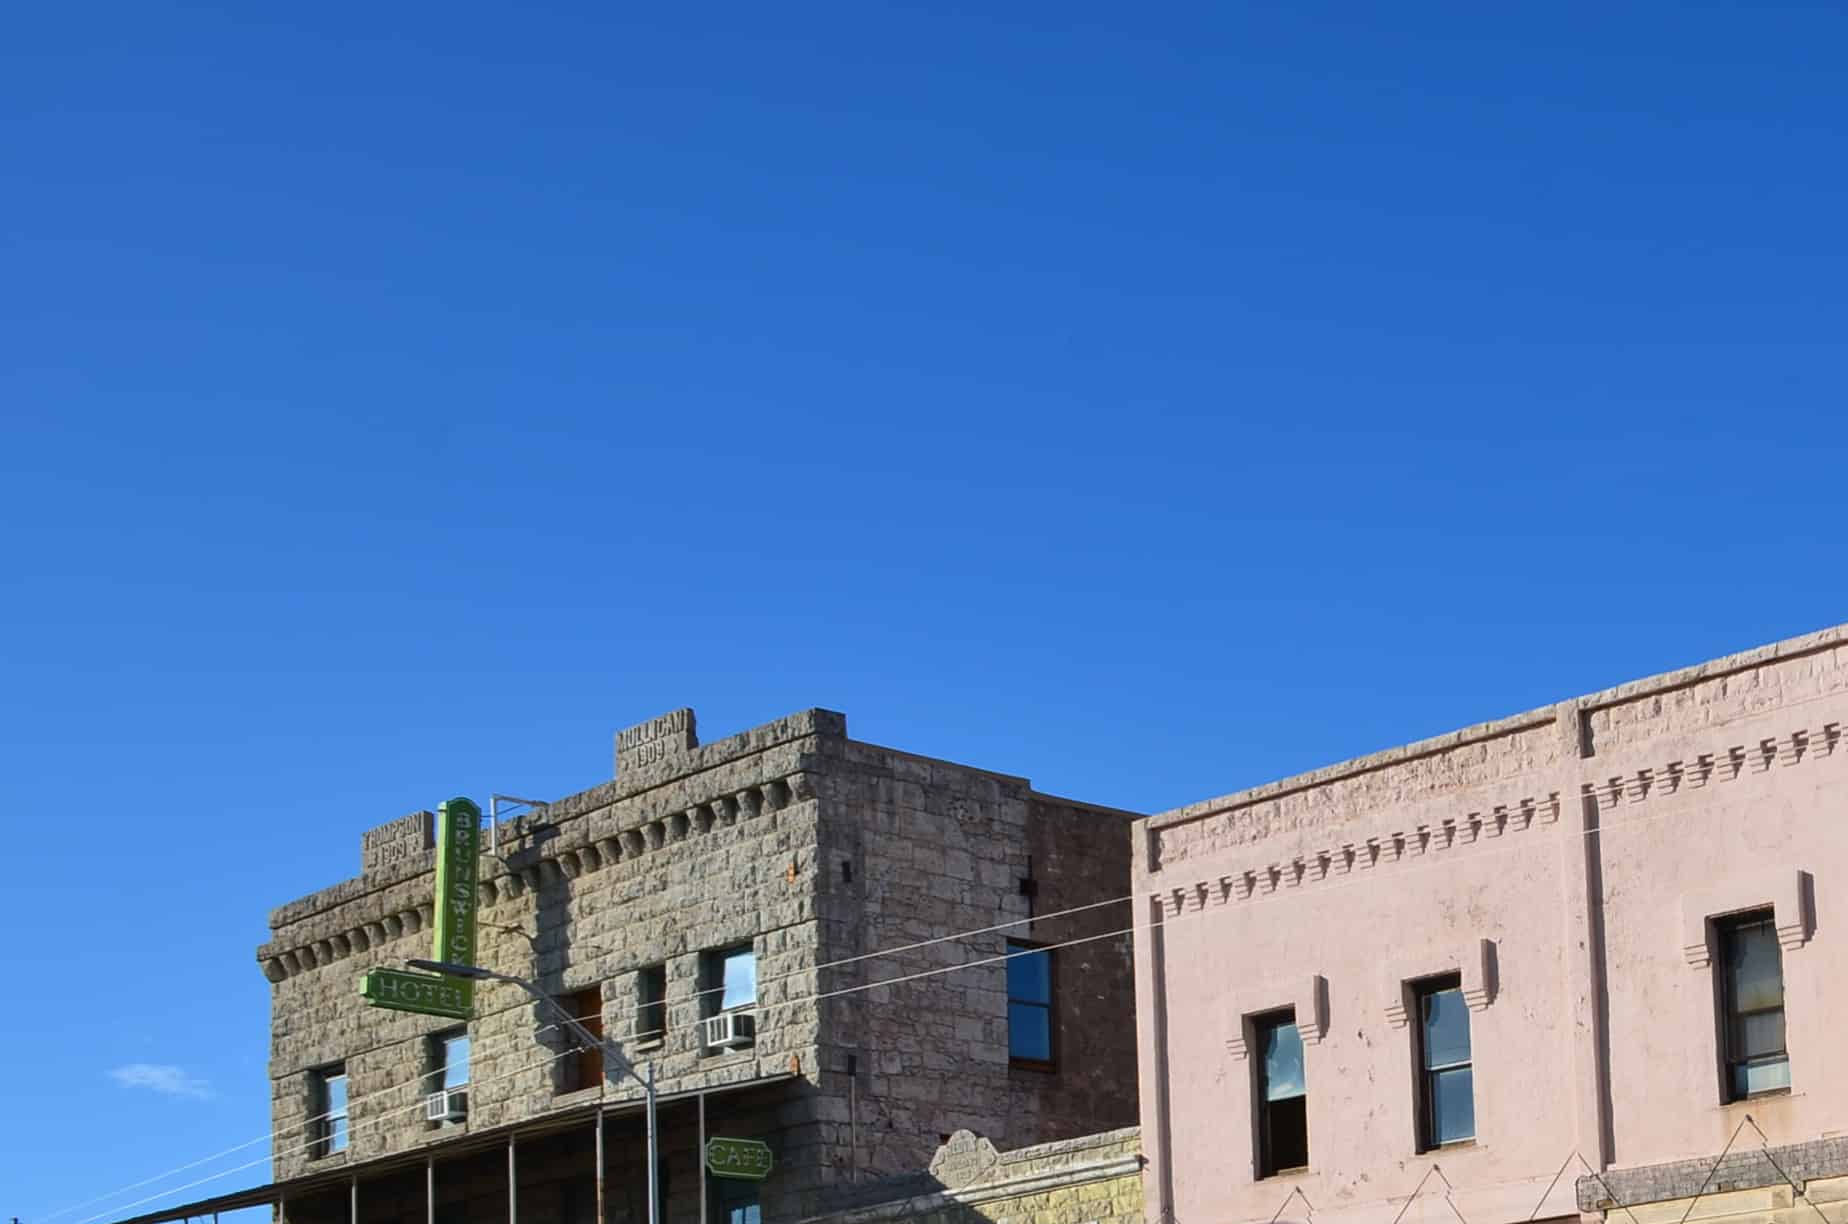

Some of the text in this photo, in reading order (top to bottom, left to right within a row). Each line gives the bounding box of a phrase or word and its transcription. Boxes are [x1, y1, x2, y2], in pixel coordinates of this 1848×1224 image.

[617, 710, 688, 752] MULLIGAN
[637, 739, 664, 768] 1909
[365, 812, 425, 850] THOMPSON
[381, 841, 407, 865] 1909
[379, 976, 465, 1008] HOTEL
[709, 1145, 769, 1168] CAFE
